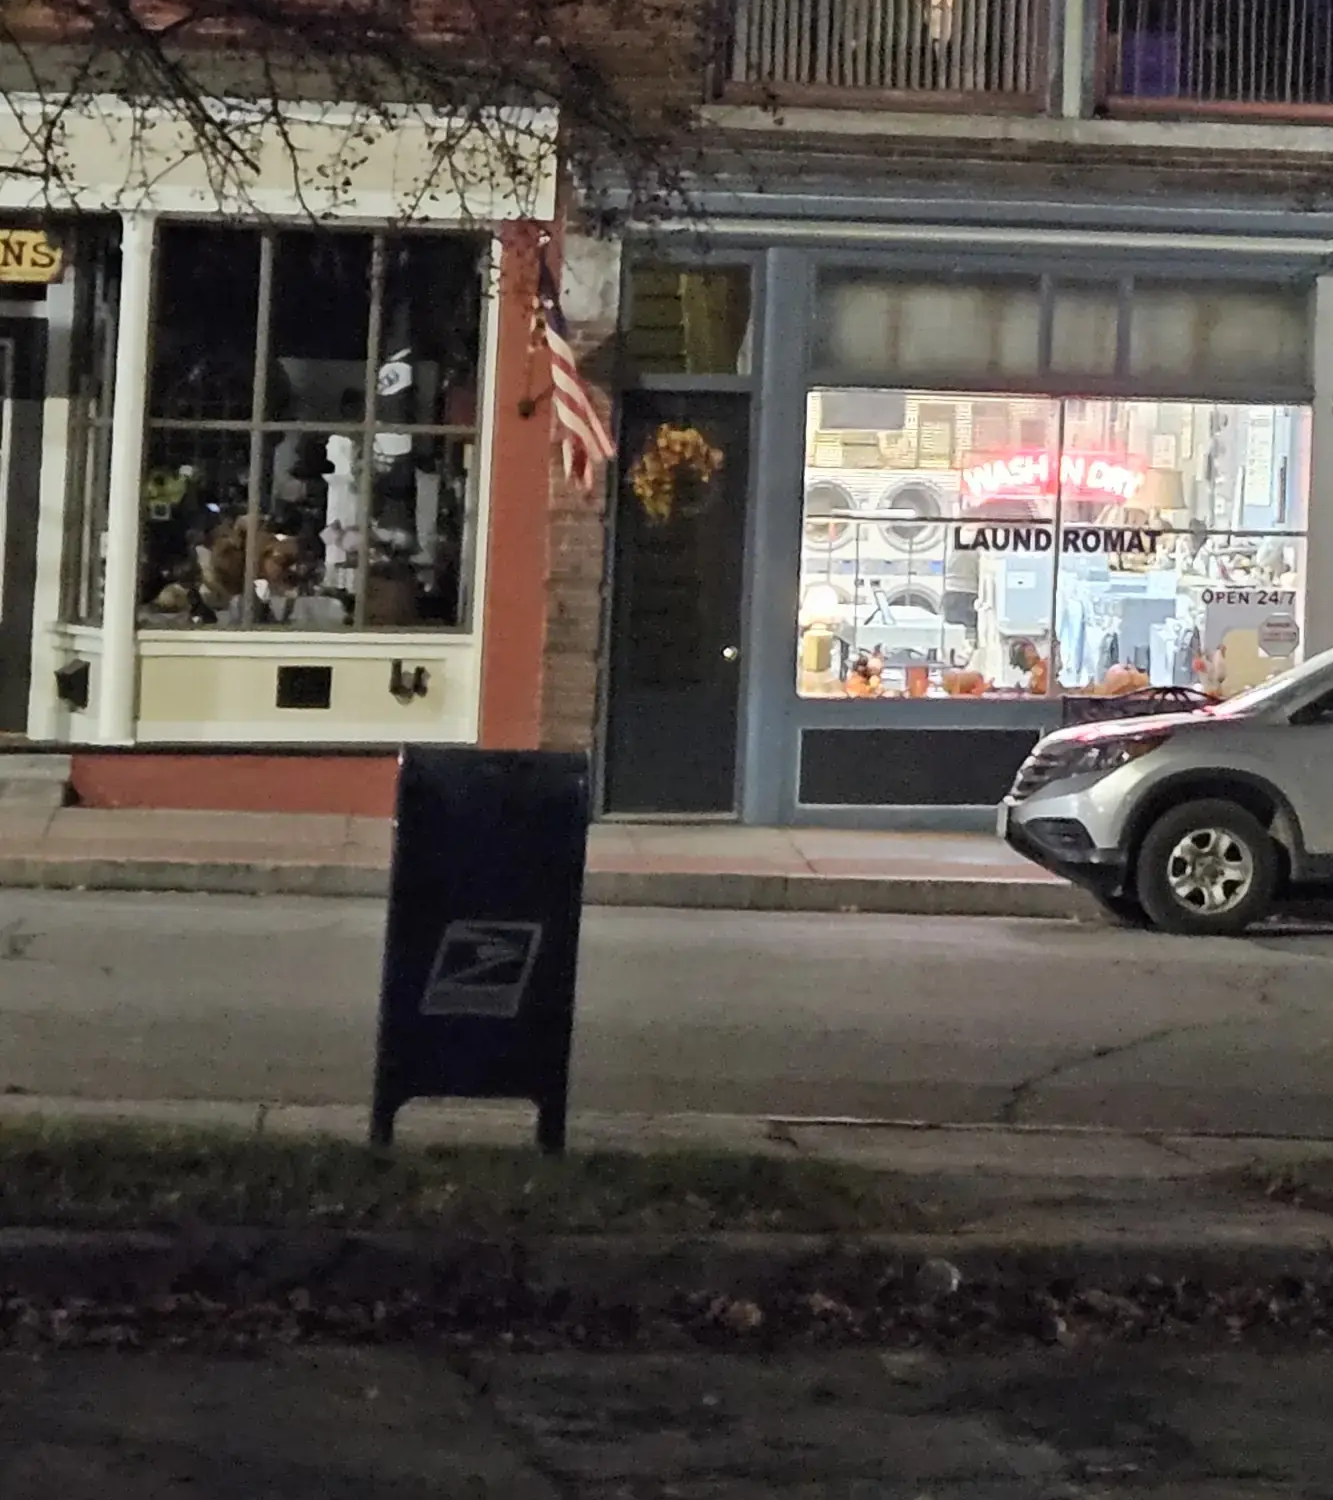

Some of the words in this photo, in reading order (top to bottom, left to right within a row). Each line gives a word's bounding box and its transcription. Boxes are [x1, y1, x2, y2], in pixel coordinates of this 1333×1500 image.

[963, 453, 1049, 498] WASH
[1087, 460, 1145, 499] DRY
[953, 526, 1164, 554] LAUNDROMAT
[1201, 588, 1250, 605] OPEN
[1257, 589, 1296, 606] 24/7
